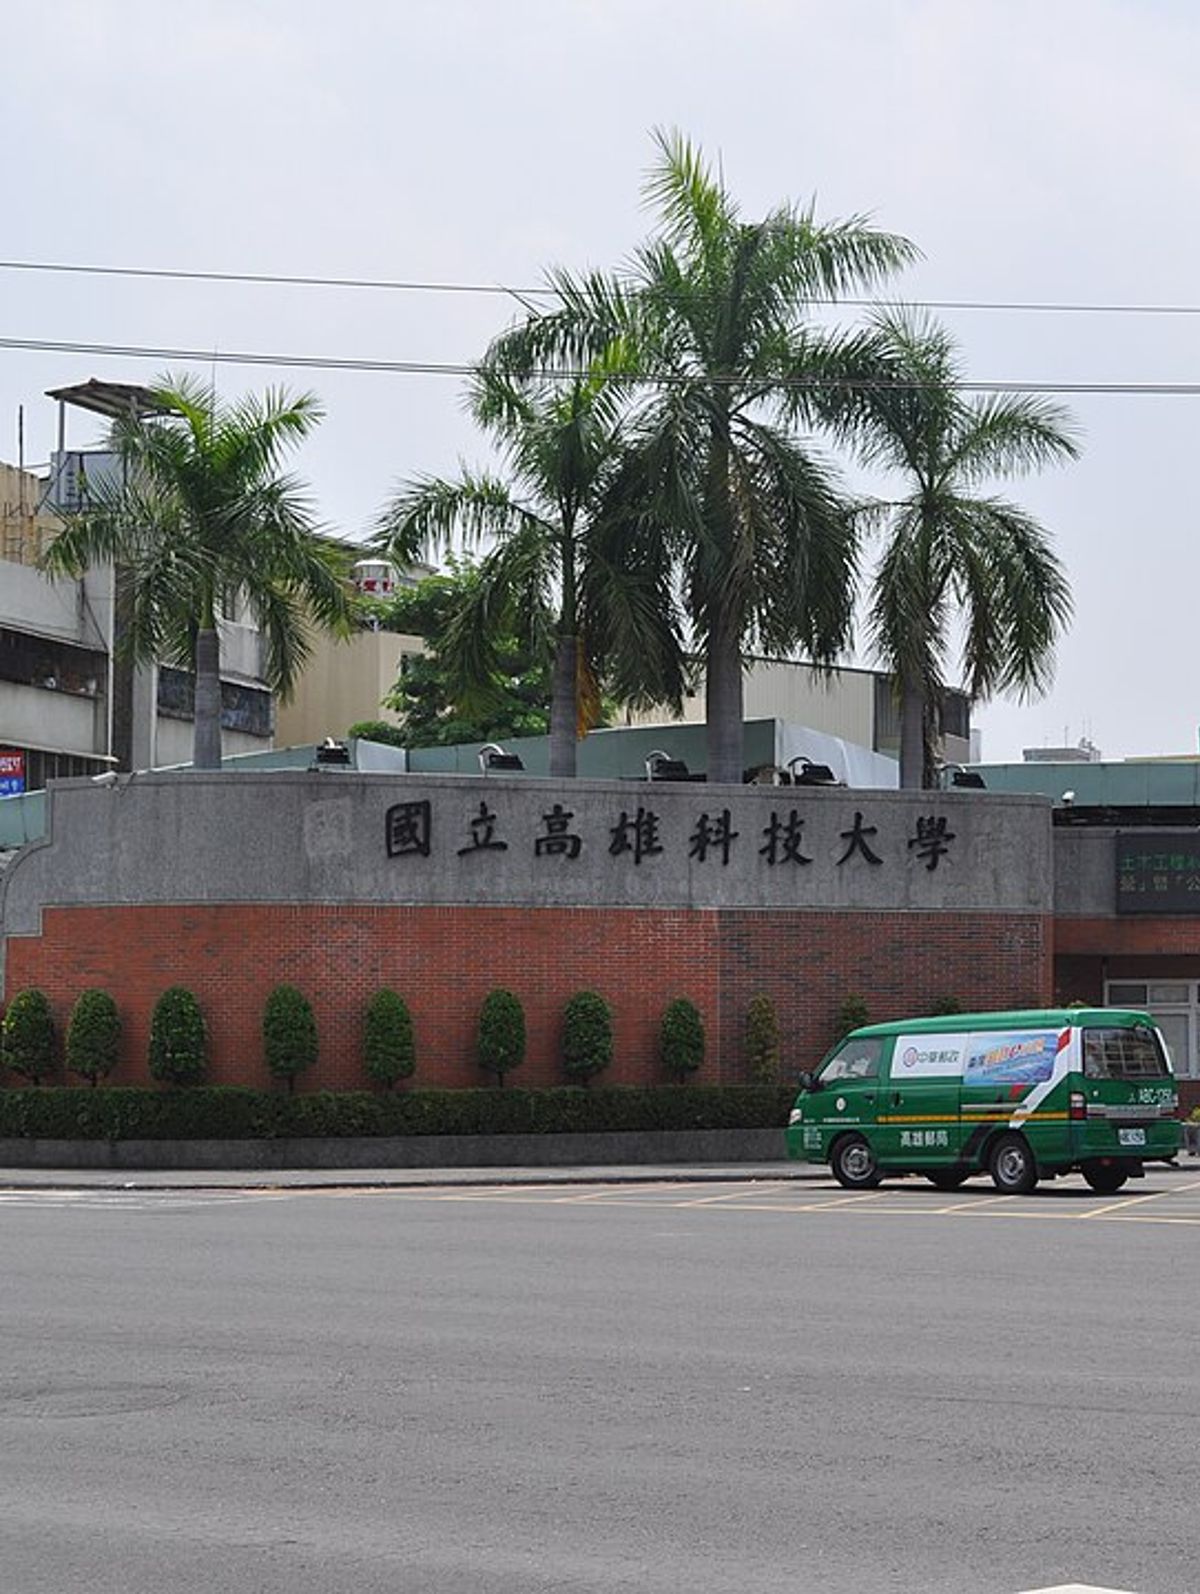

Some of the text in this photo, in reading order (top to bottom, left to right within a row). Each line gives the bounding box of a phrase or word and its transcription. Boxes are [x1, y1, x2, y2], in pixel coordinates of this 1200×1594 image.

[384, 799, 957, 870] 國立高雄科技大學
[917, 1049, 960, 1064] 中華郵政
[900, 1130, 949, 1148] 高雄郵局
